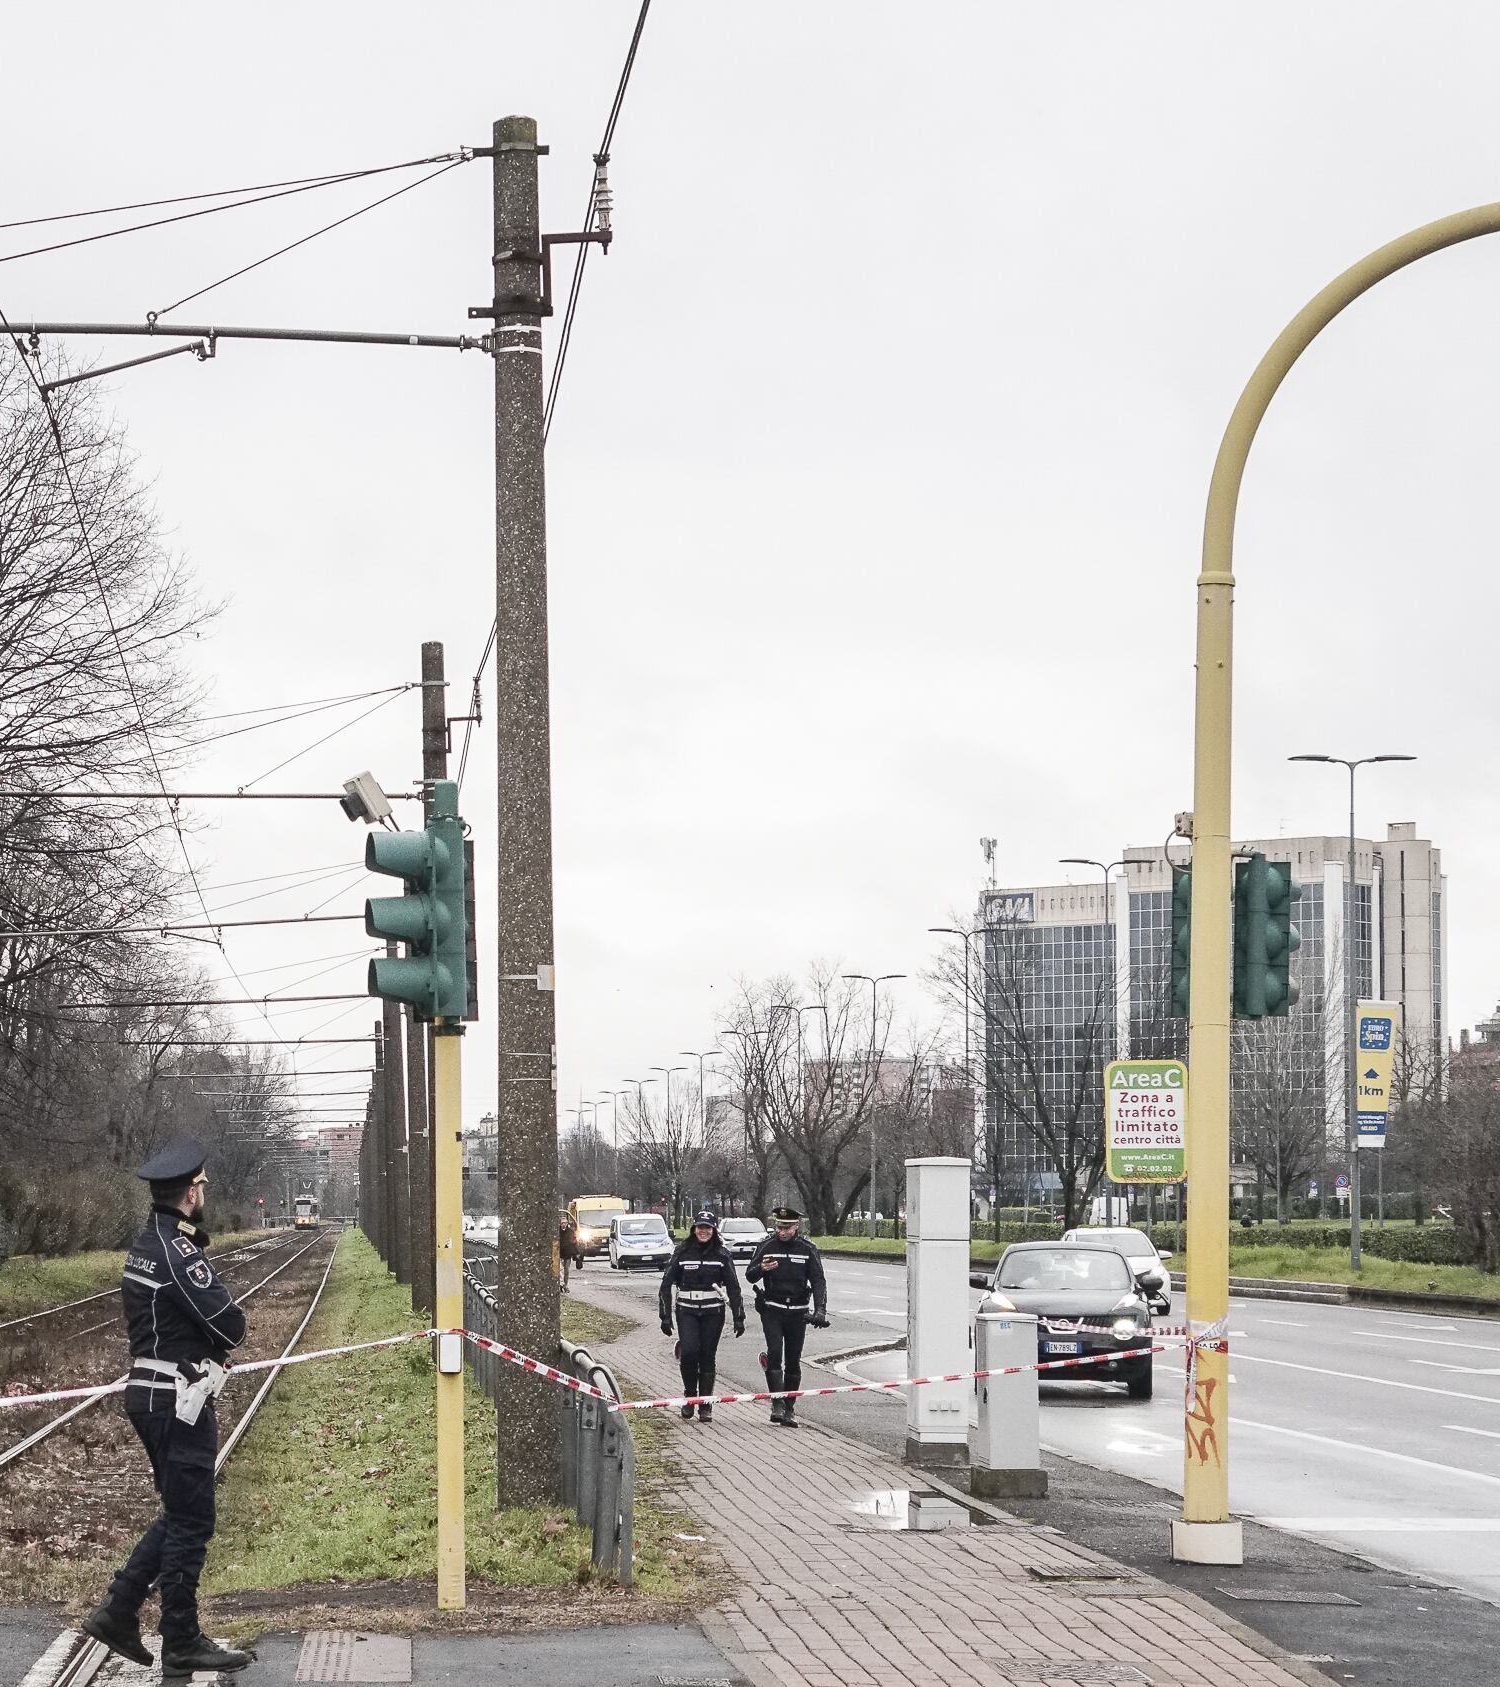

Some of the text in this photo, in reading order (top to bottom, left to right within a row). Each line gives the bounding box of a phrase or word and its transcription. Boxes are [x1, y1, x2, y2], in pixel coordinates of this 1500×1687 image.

[1367, 1024, 1385, 1032] EURO
[1365, 1031, 1385, 1042] Spin
[1119, 1092, 1174, 1104] Zona a
[1117, 1105, 1176, 1118] traffico
[1115, 1120, 1179, 1132] limitato
[1113, 1134, 1181, 1145] centro città
[1120, 1153, 1175, 1161] www.AreaC.it
[132, 1256, 157, 1274] LOCALE
